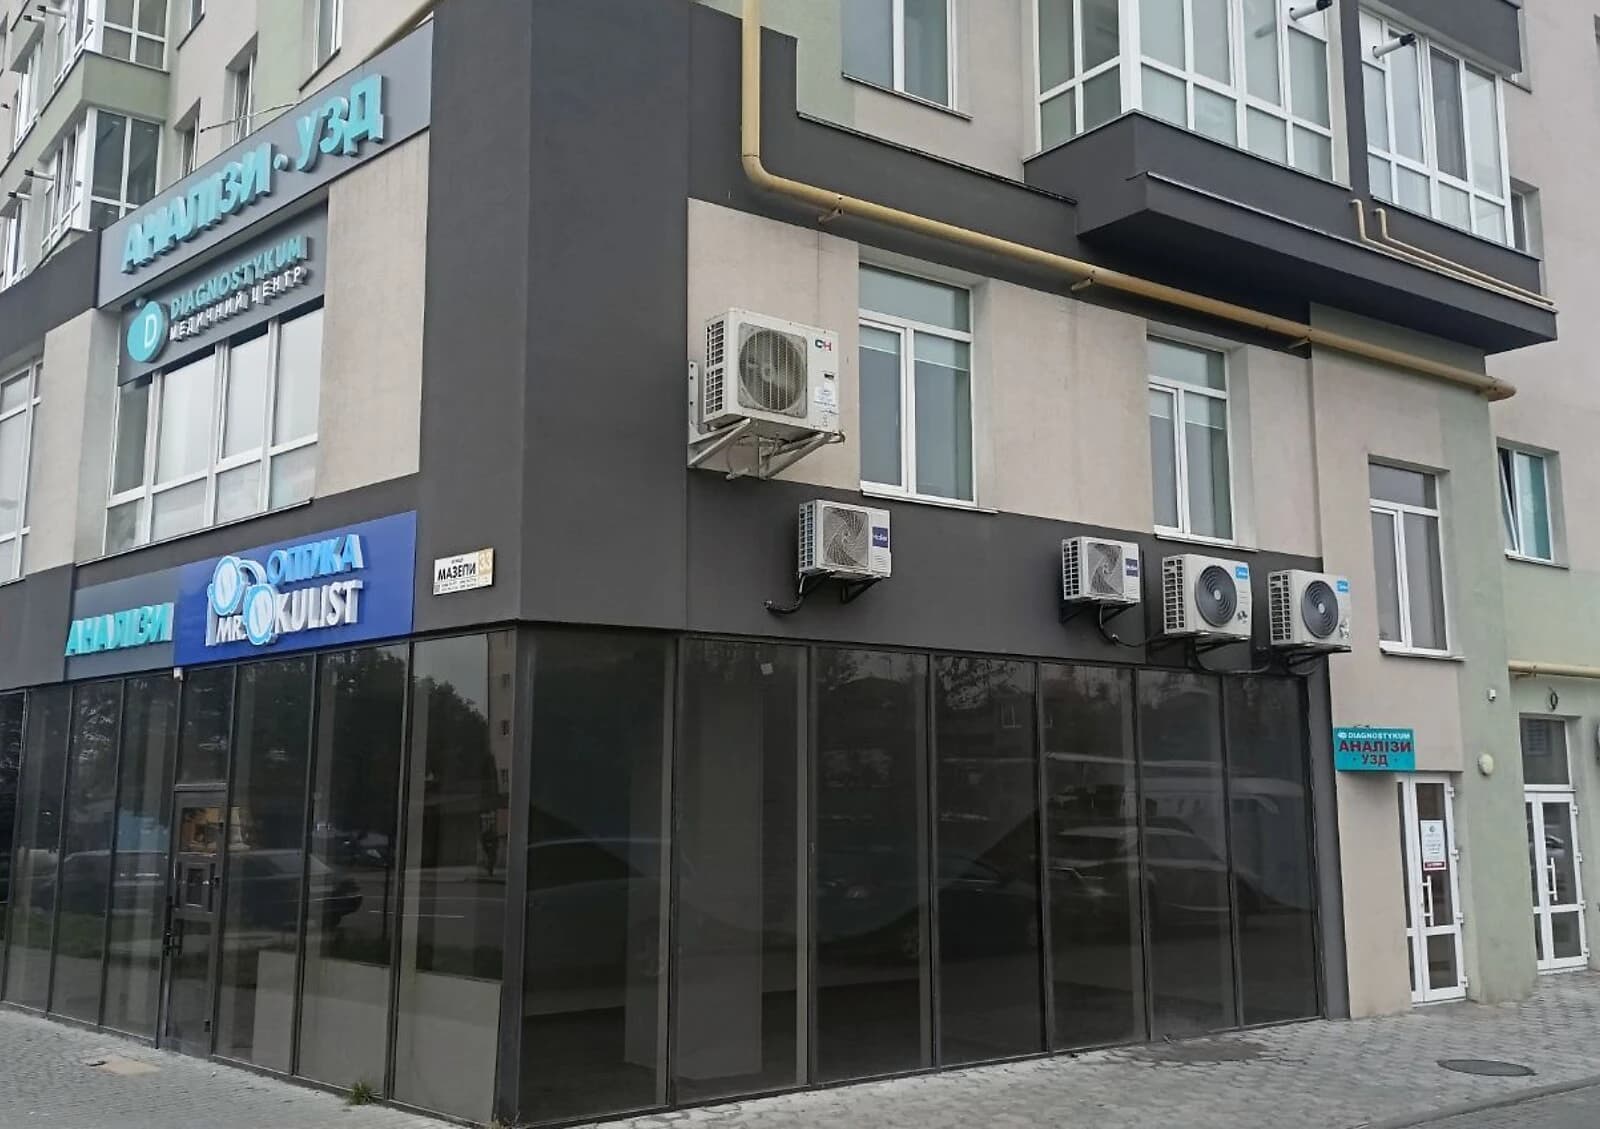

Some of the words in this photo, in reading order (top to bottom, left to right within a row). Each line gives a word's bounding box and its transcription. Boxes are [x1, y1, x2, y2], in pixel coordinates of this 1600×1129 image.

[121, 142, 272, 274] АНАЛІЗИ
[296, 74, 384, 172] УЗД
[171, 235, 308, 320] DIAGNOSTYKUM
[169, 290, 249, 341] МЕДИЧНИЙ
[252, 266, 307, 304] ЦЕНТР
[267, 534, 364, 585] ОПТИКА
[438, 562, 476, 580] МАЗЕПИ
[64, 602, 175, 656] АНАЛІЗИ
[1339, 741, 1412, 752] АНАЛІЗИ
[1348, 731, 1411, 740] DIAGNOSTYKUM
[1361, 754, 1388, 767] УЗД
